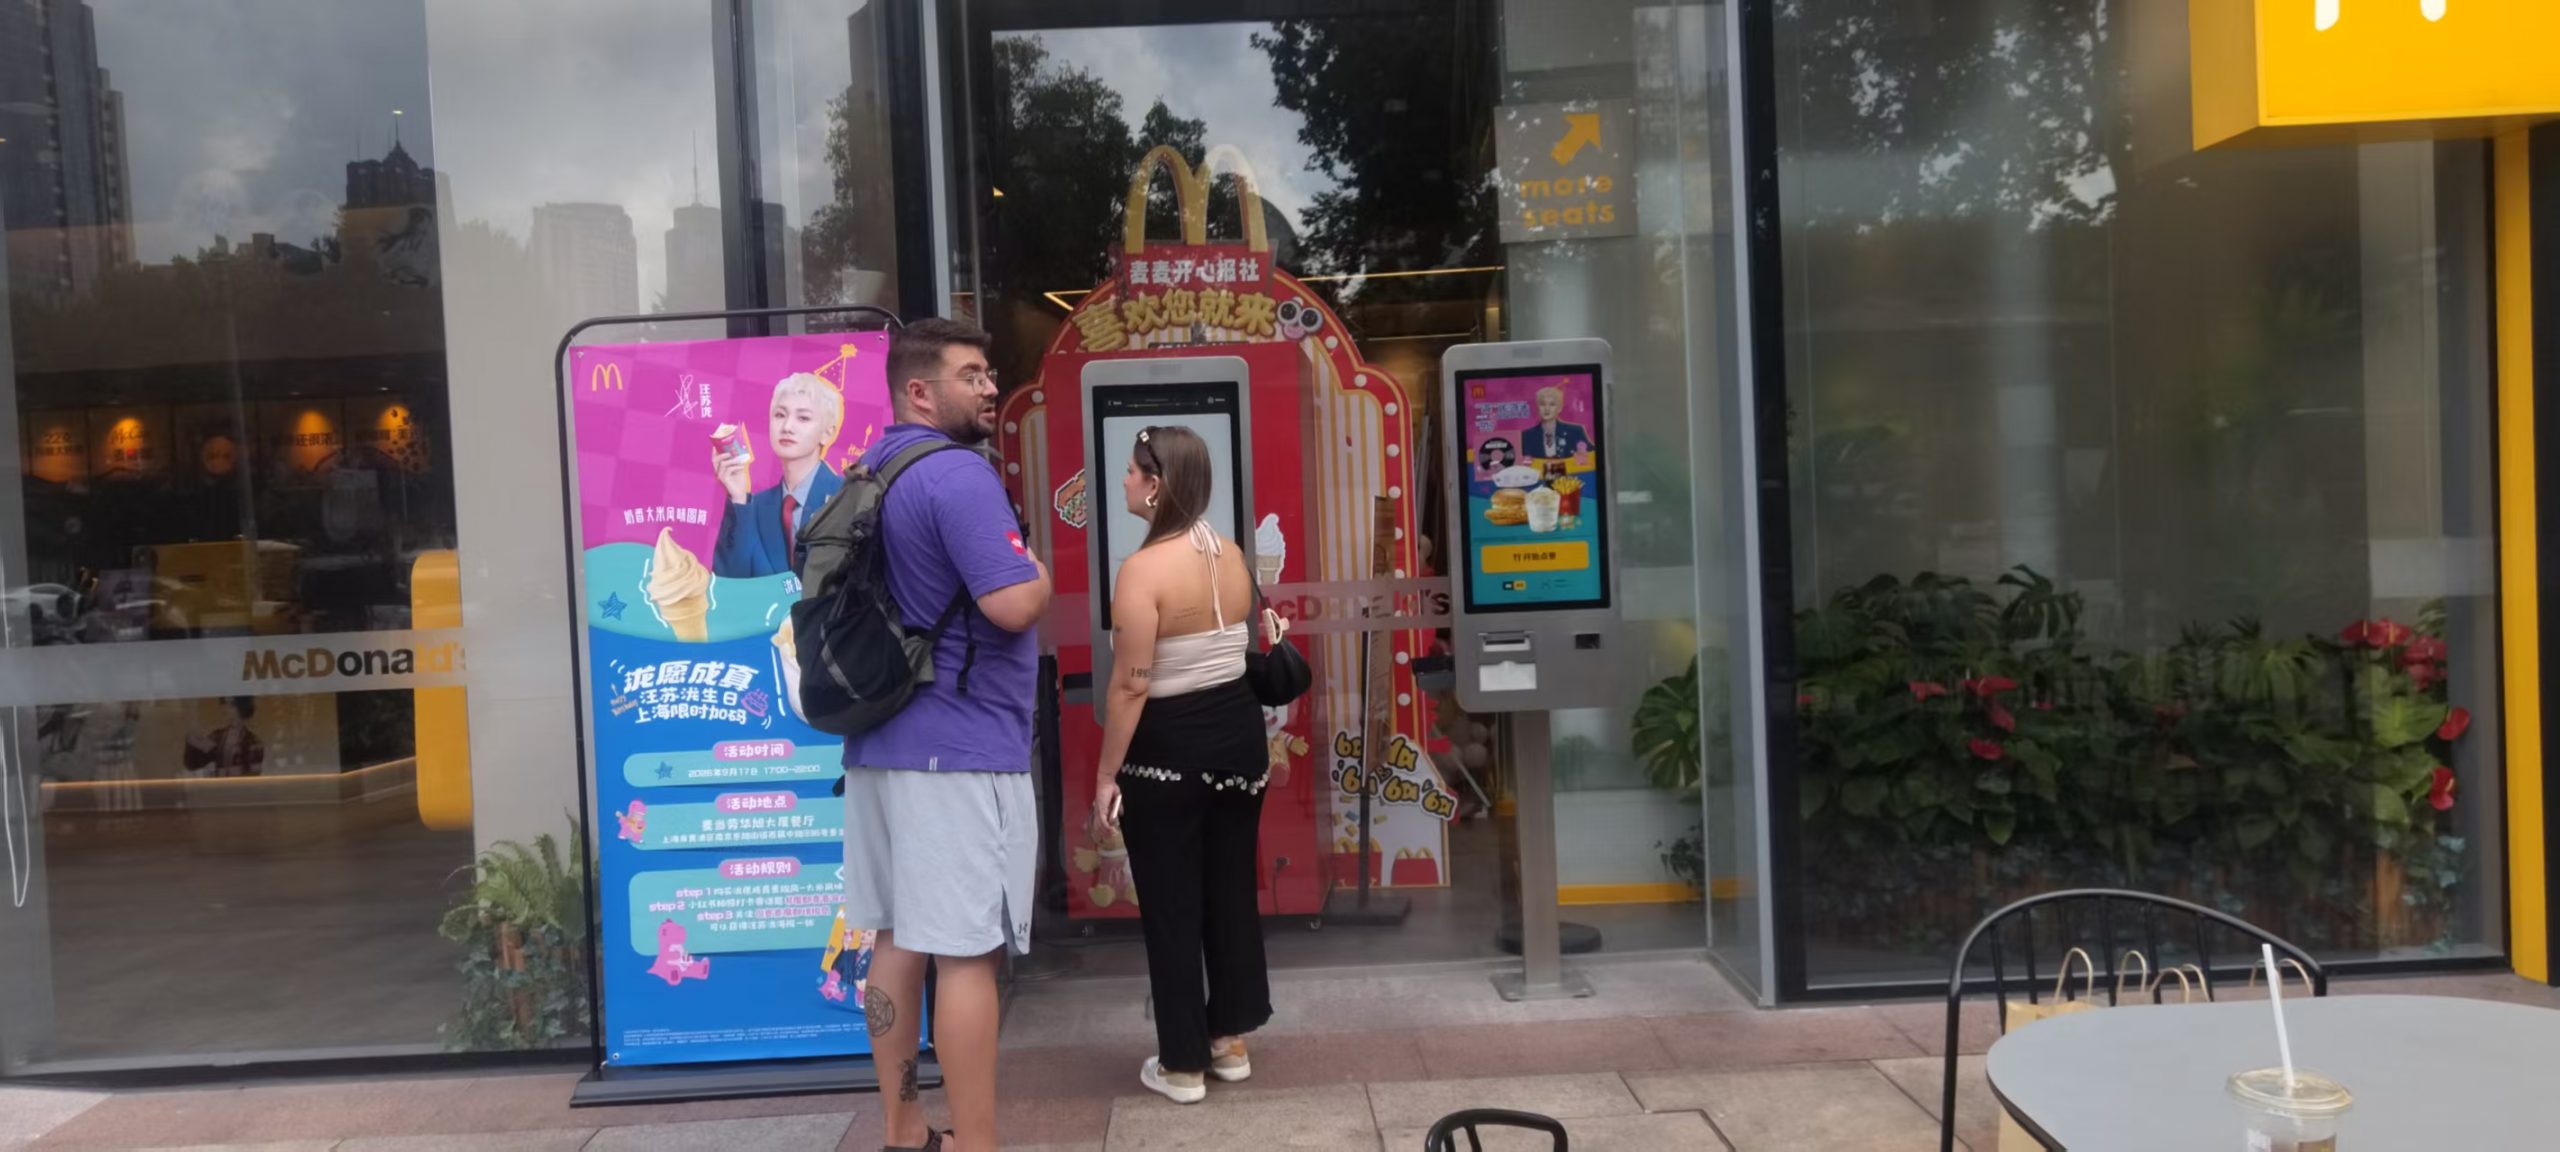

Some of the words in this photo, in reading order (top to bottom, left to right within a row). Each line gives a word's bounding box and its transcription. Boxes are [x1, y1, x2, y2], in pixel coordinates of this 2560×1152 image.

[1520, 176, 1613, 198] more
[1523, 200, 1615, 229] seats
[1130, 258, 1260, 285] 麦麦开心报社
[1072, 287, 1276, 352] 喜欢您就来
[624, 506, 708, 526] 奶香大米风味圆筒
[635, 704, 747, 725] 上海限时加码
[724, 743, 784, 758] 活动时间
[727, 796, 787, 810] 活动地点
[730, 862, 791, 876] 活动规则
